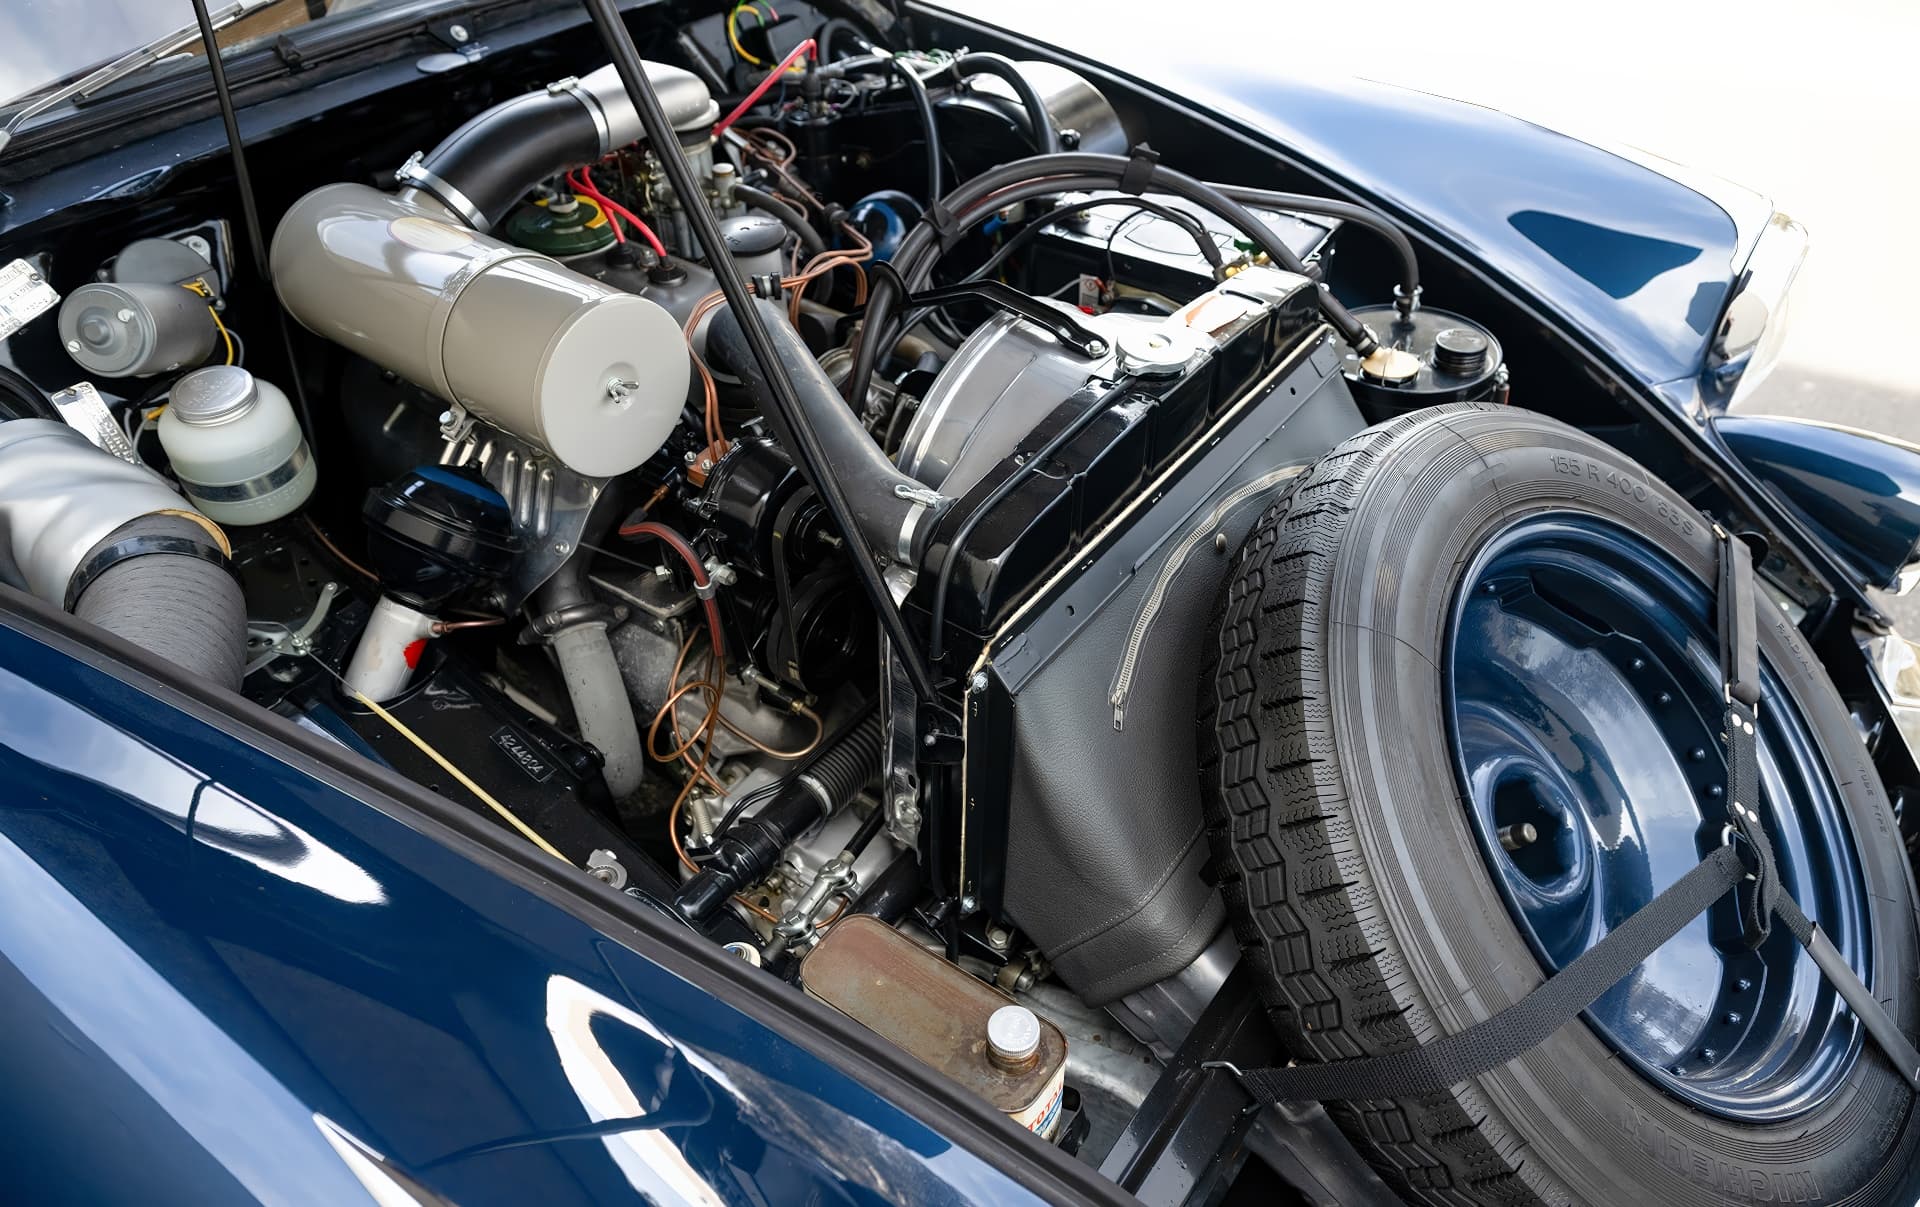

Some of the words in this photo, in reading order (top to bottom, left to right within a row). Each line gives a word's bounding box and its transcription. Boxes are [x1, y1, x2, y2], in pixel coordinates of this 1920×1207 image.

[1550, 455, 1581, 477] 155
[1587, 463, 1601, 482] R
[1606, 471, 1649, 503] 400
[1775, 622, 1814, 681] RADIAL
